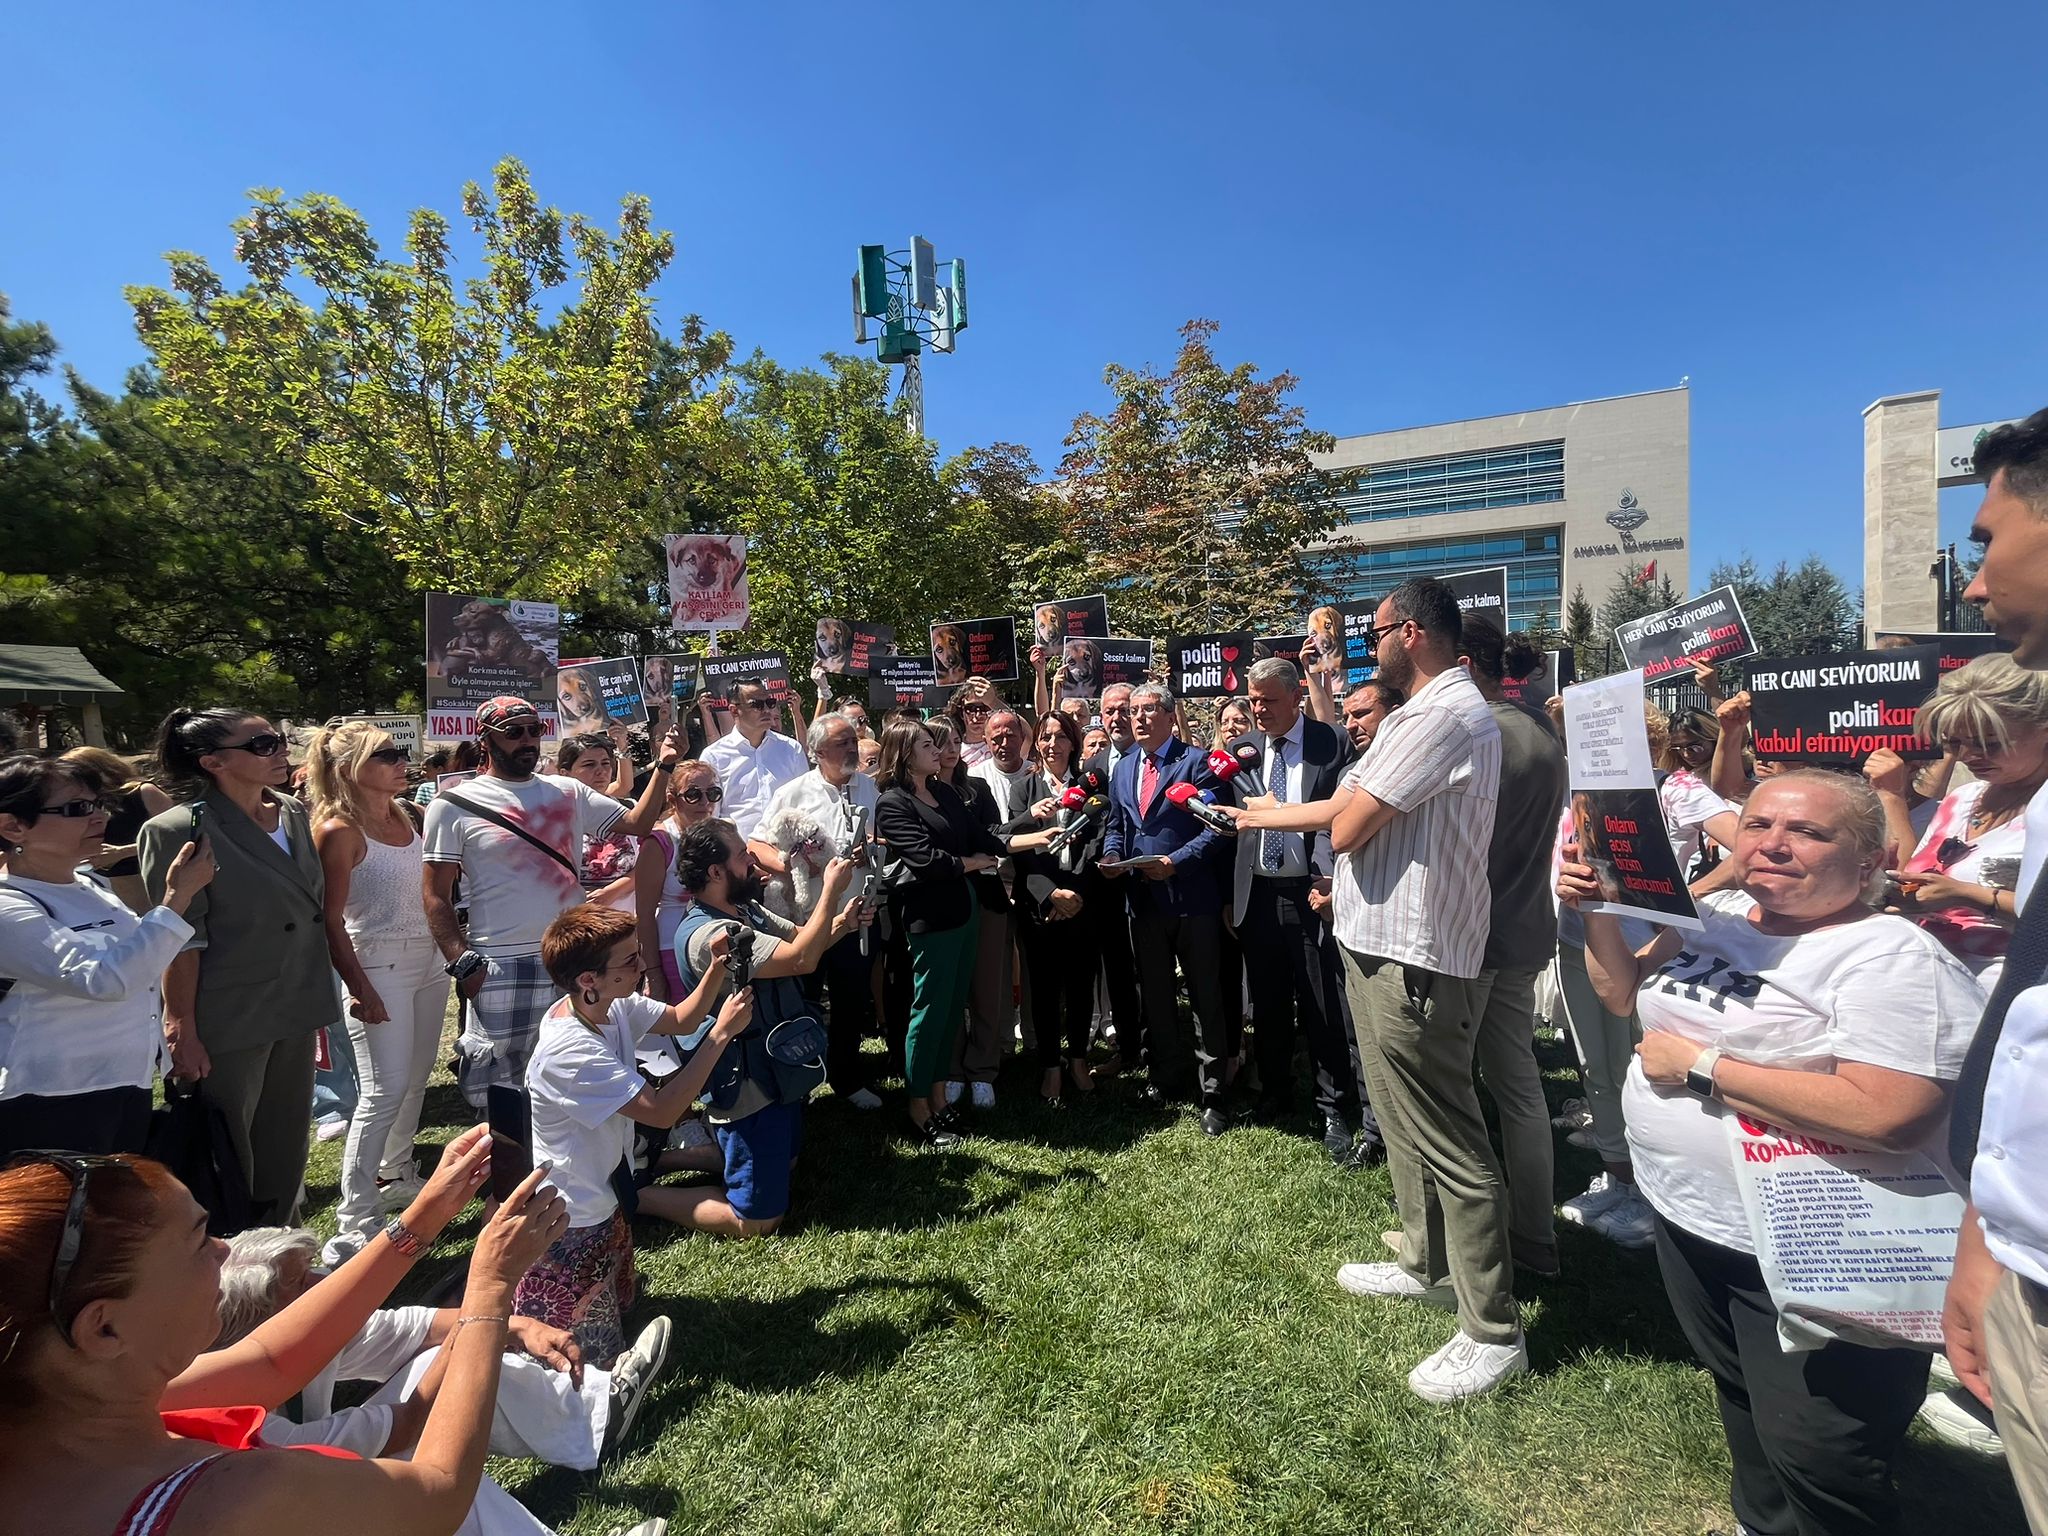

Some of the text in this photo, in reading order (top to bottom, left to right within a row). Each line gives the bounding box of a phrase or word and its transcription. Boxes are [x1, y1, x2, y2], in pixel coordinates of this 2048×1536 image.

[1573, 543, 1619, 558] ANAYASA
[1456, 592, 1501, 610] ssiz kalma
[1067, 611, 1089, 620] Onların
[1344, 613, 1356, 626] Bir
[1357, 613, 1371, 625] can
[1067, 621, 1084, 629] acısı
[1623, 599, 1727, 644] HER CANI SEVİYORUM
[1344, 625, 1359, 637] ses
[854, 632, 876, 643] Onların
[969, 632, 994, 642] Onların
[1680, 623, 1740, 656] politikanı
[852, 643, 868, 651] acısı
[970, 644, 986, 653] acısı
[851, 650, 868, 660] bizim
[970, 653, 989, 662] bizim
[1103, 652, 1146, 663] Sessiz kalma
[1181, 641, 1221, 670] politi
[468, 666, 497, 675] Korkma
[705, 657, 782, 675] HER CANI SEVİYORUM
[1643, 656, 1672, 678] abul
[888, 669, 903, 677] milyon
[1751, 672, 1779, 692] HER
[1780, 668, 1816, 690] CANI
[1818, 660, 1921, 688] SEVİYORUM
[451, 675, 468, 686] Öyle
[470, 678, 509, 687] olmayacak
[598, 672, 634, 687] Bir can için
[1182, 665, 1222, 694] politi
[602, 689, 614, 697] ses
[896, 693, 924, 703] öyle mi?
[605, 691, 640, 711] gelecek için
[607, 706, 625, 718] umut
[1828, 699, 1921, 734] politikan
[431, 716, 462, 735] YASA
[1754, 727, 1932, 759] kabul etmiyorum!
[1604, 815, 1638, 835] Onların
[1608, 839, 1633, 853] acısı
[1613, 853, 1644, 873] bizim
[1622, 875, 1676, 896] utancımız!
[1776, 1170, 1801, 1178] SİYAH
[1779, 1179, 1820, 1187] SCANNER
[1795, 1187, 1825, 1195] KOPYA
[1826, 1186, 1862, 1194] (XEROX)
[1775, 1197, 1796, 1205] PLAN
[1798, 1195, 1827, 1203] PROJE
[1801, 1203, 1873, 1213] (PLOTTER) ÇIKTI
[1799, 1212, 1872, 1222] (PLOTTER) ÇIKTI
[1800, 1221, 1844, 1230] FOTOKOPİ
[1804, 1230, 1844, 1238] PLOTTER
[1775, 1239, 1840, 1249] CİLT ÇEŞİTLERİ
[1778, 1249, 1809, 1257] ASETAT
[1826, 1248, 1873, 1256] AYDINGER
[1875, 1245, 1924, 1255] FOTOKOPİ
[1781, 1258, 1801, 1266] TÜM
[1803, 1257, 1828, 1265] BÜRO
[1844, 1255, 1893, 1264] KIRTASİYE
[1784, 1264, 1934, 1275] BİLGİSAYAR SARF MALZEMELERİ
[1836, 1275, 1867, 1283] LASER
[1868, 1275, 1908, 1284] KARTUŞ
[1791, 1285, 1850, 1293] KAŞE YAPIMI
